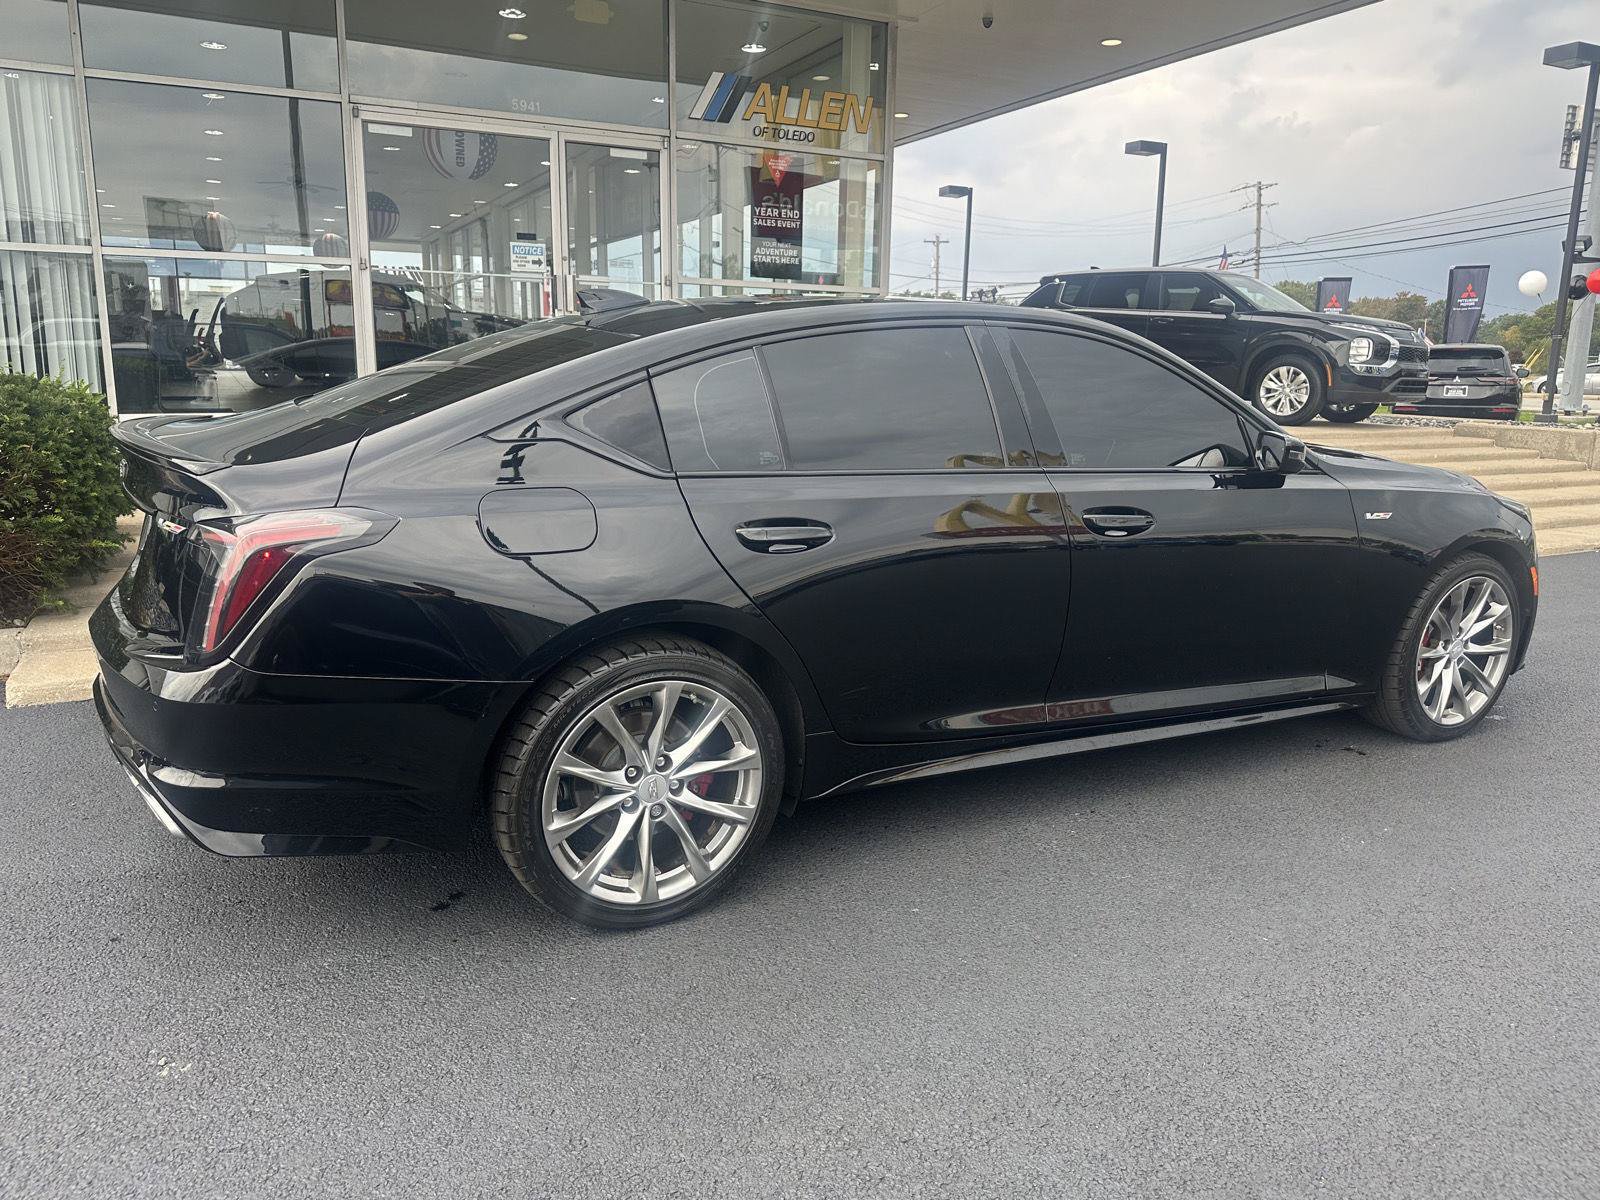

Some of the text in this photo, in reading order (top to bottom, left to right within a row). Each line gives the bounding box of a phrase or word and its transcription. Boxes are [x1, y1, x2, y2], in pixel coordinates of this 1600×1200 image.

[511, 98, 541, 112] 5941
[742, 82, 874, 134] ALLEN
[753, 125, 816, 143] OF TOLEDO
[754, 206, 800, 219] YEAR END
[753, 217, 801, 229] SALES EVENT
[513, 246, 543, 255] NOTICE
[755, 247, 798, 257] ADVENTURE
[753, 255, 800, 265] STARTS HERE
